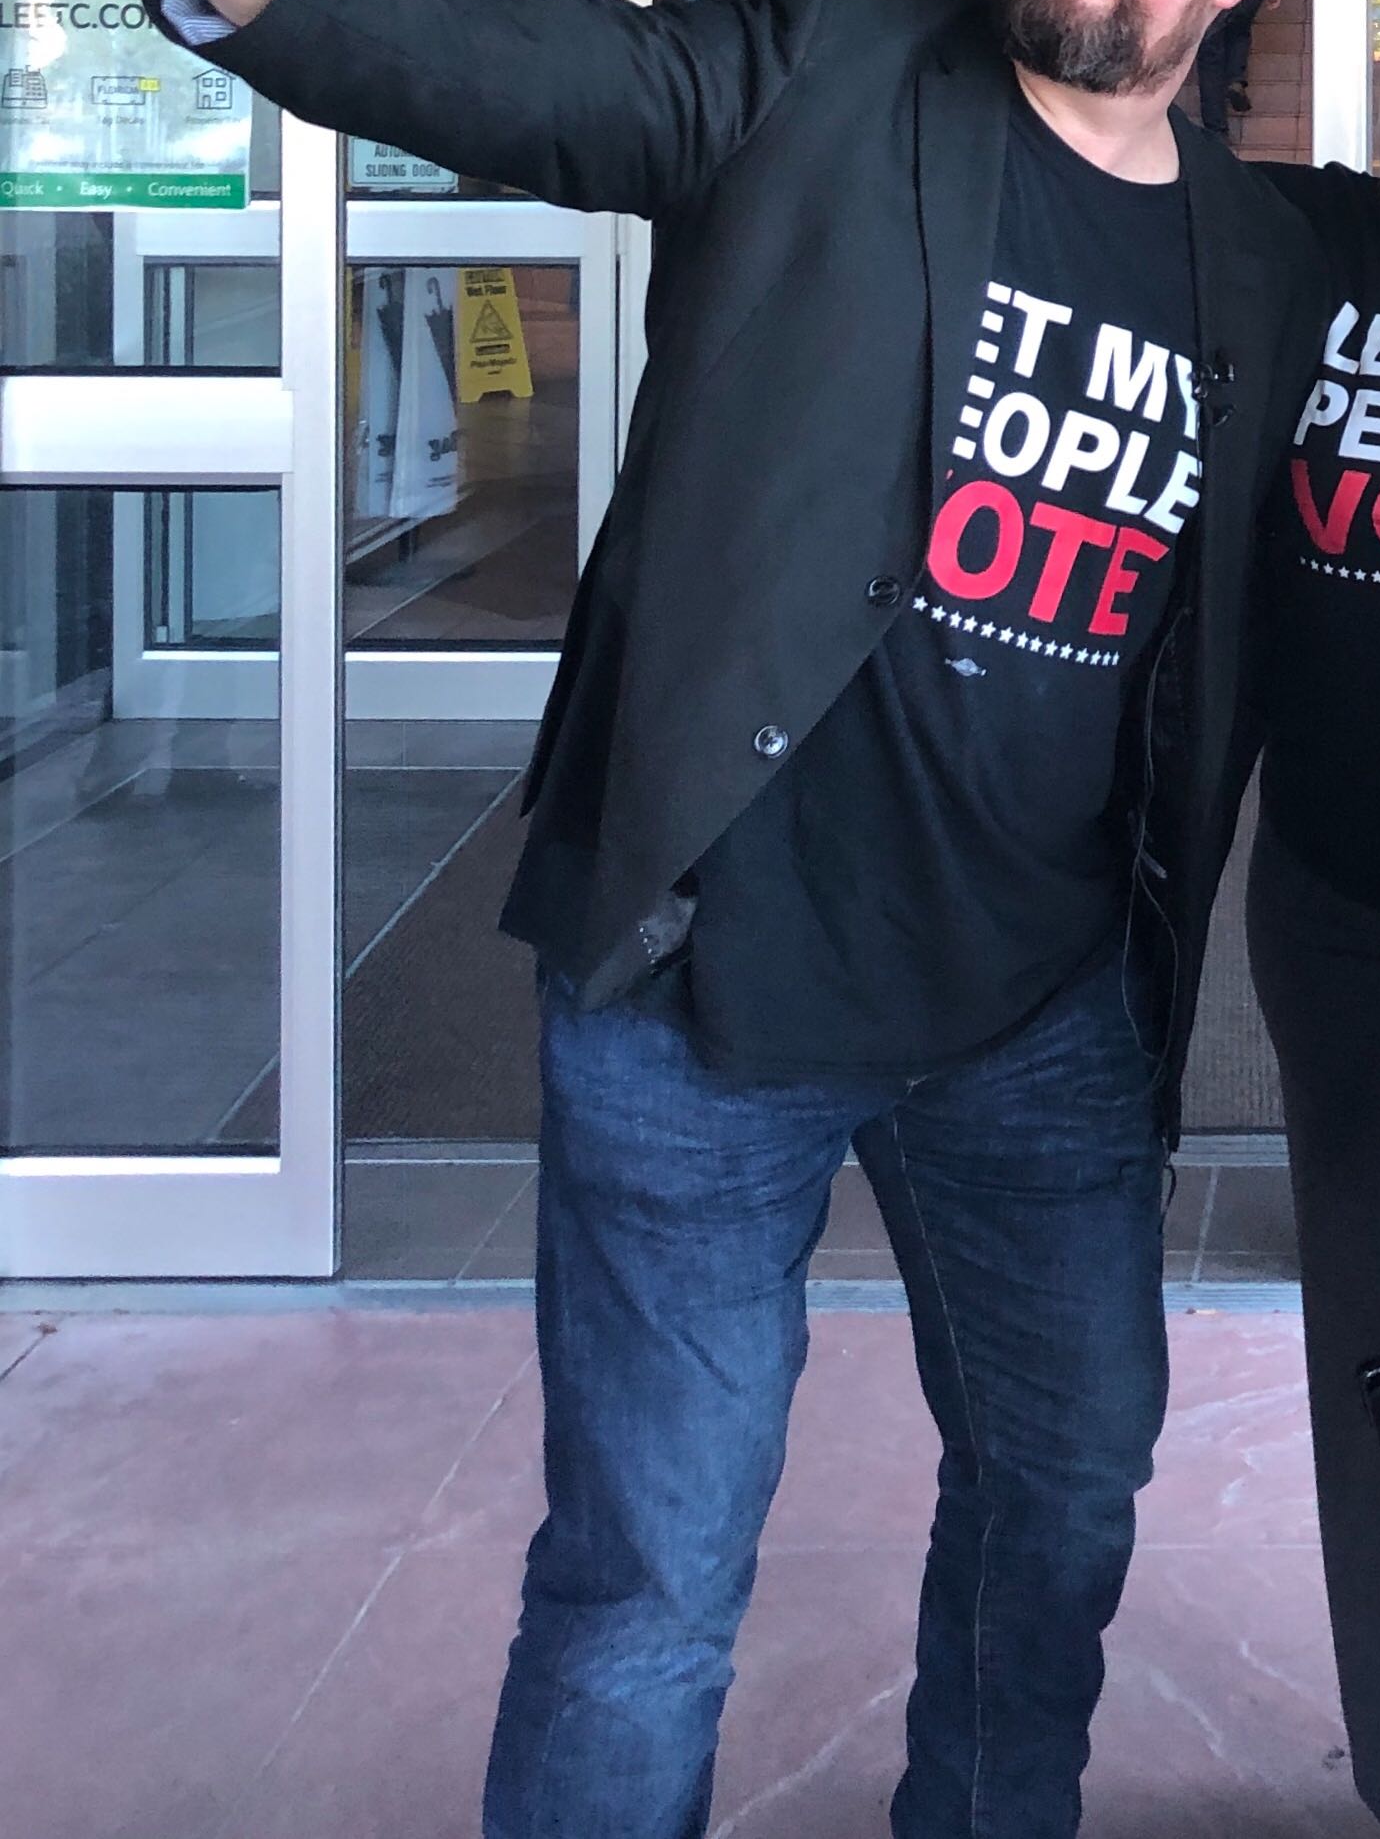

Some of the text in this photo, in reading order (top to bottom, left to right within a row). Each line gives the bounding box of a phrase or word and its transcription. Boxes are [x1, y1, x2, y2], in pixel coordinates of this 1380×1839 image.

[366, 164, 407, 177] SLIDING
[1, 181, 232, 199] Quick Easy Convenient
[927, 479, 1170, 636] OTE
